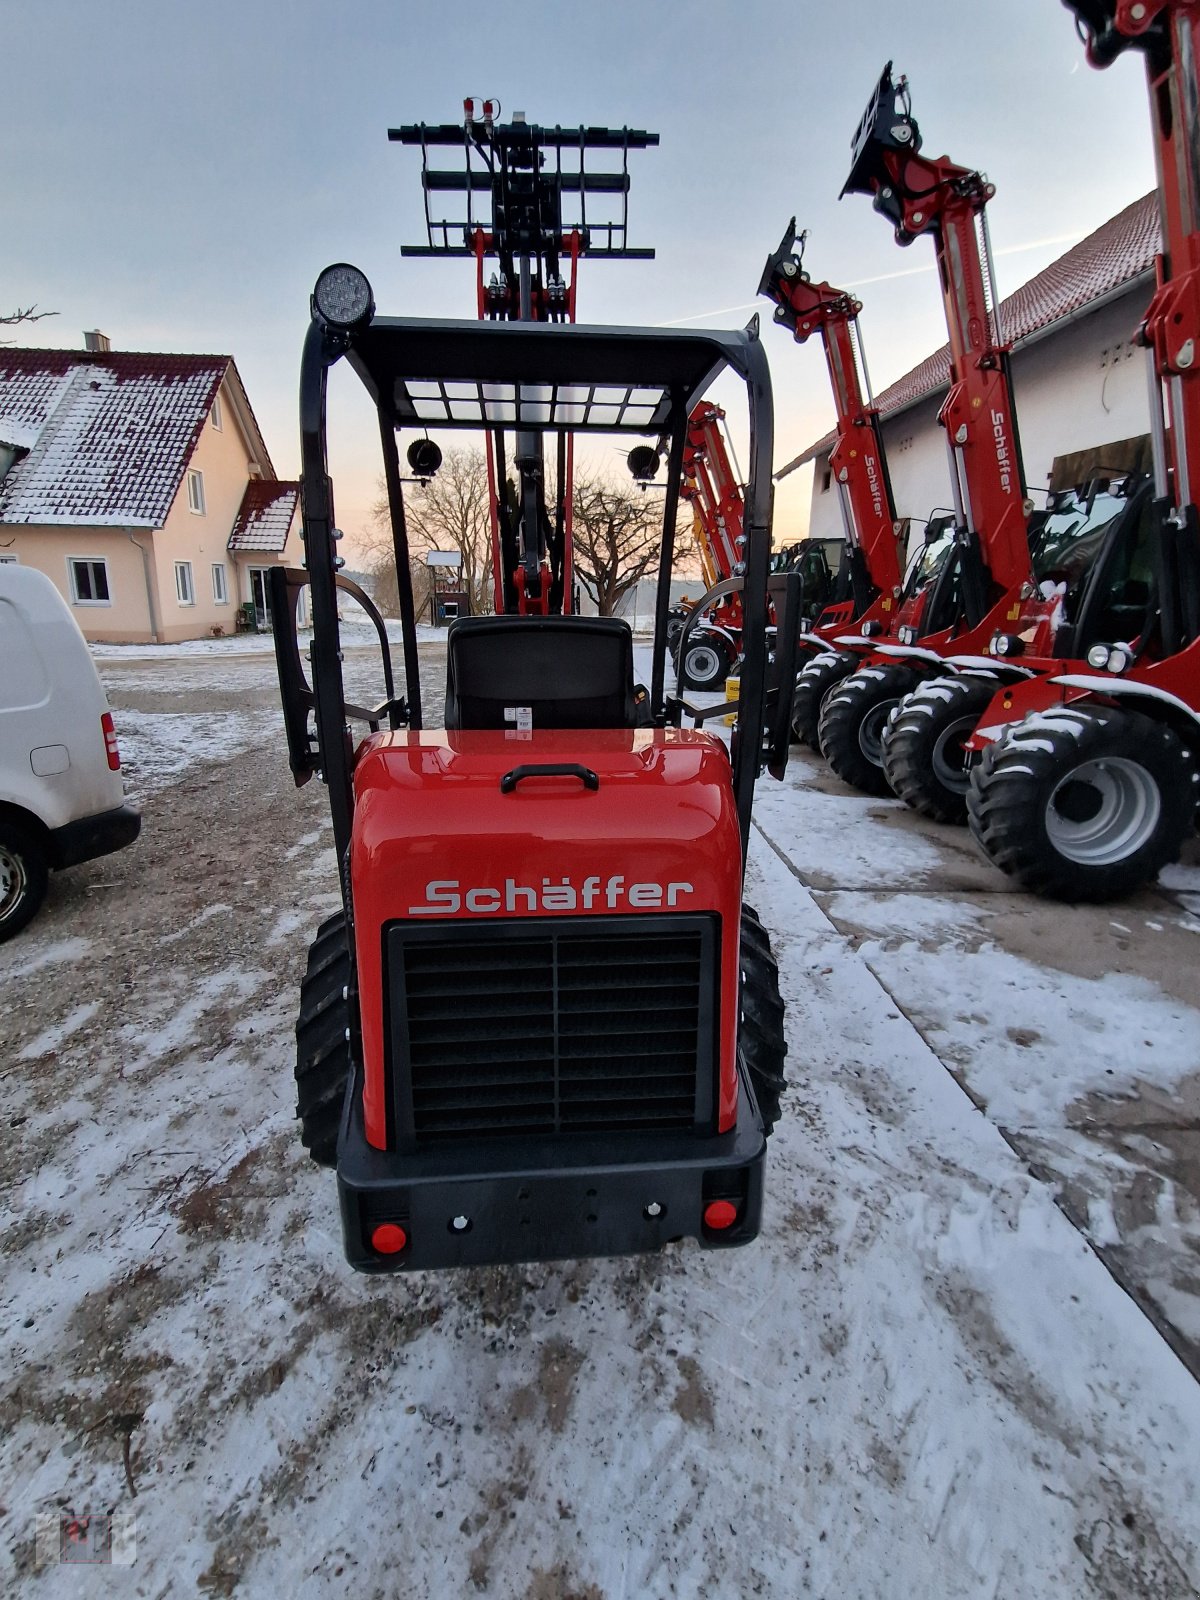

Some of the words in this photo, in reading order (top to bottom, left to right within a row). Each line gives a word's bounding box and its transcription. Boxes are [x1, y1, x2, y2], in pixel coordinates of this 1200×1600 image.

[991, 409, 1011, 495] Schäffer
[864, 454, 882, 518] Schäffer
[408, 876, 694, 914] Schäffer
